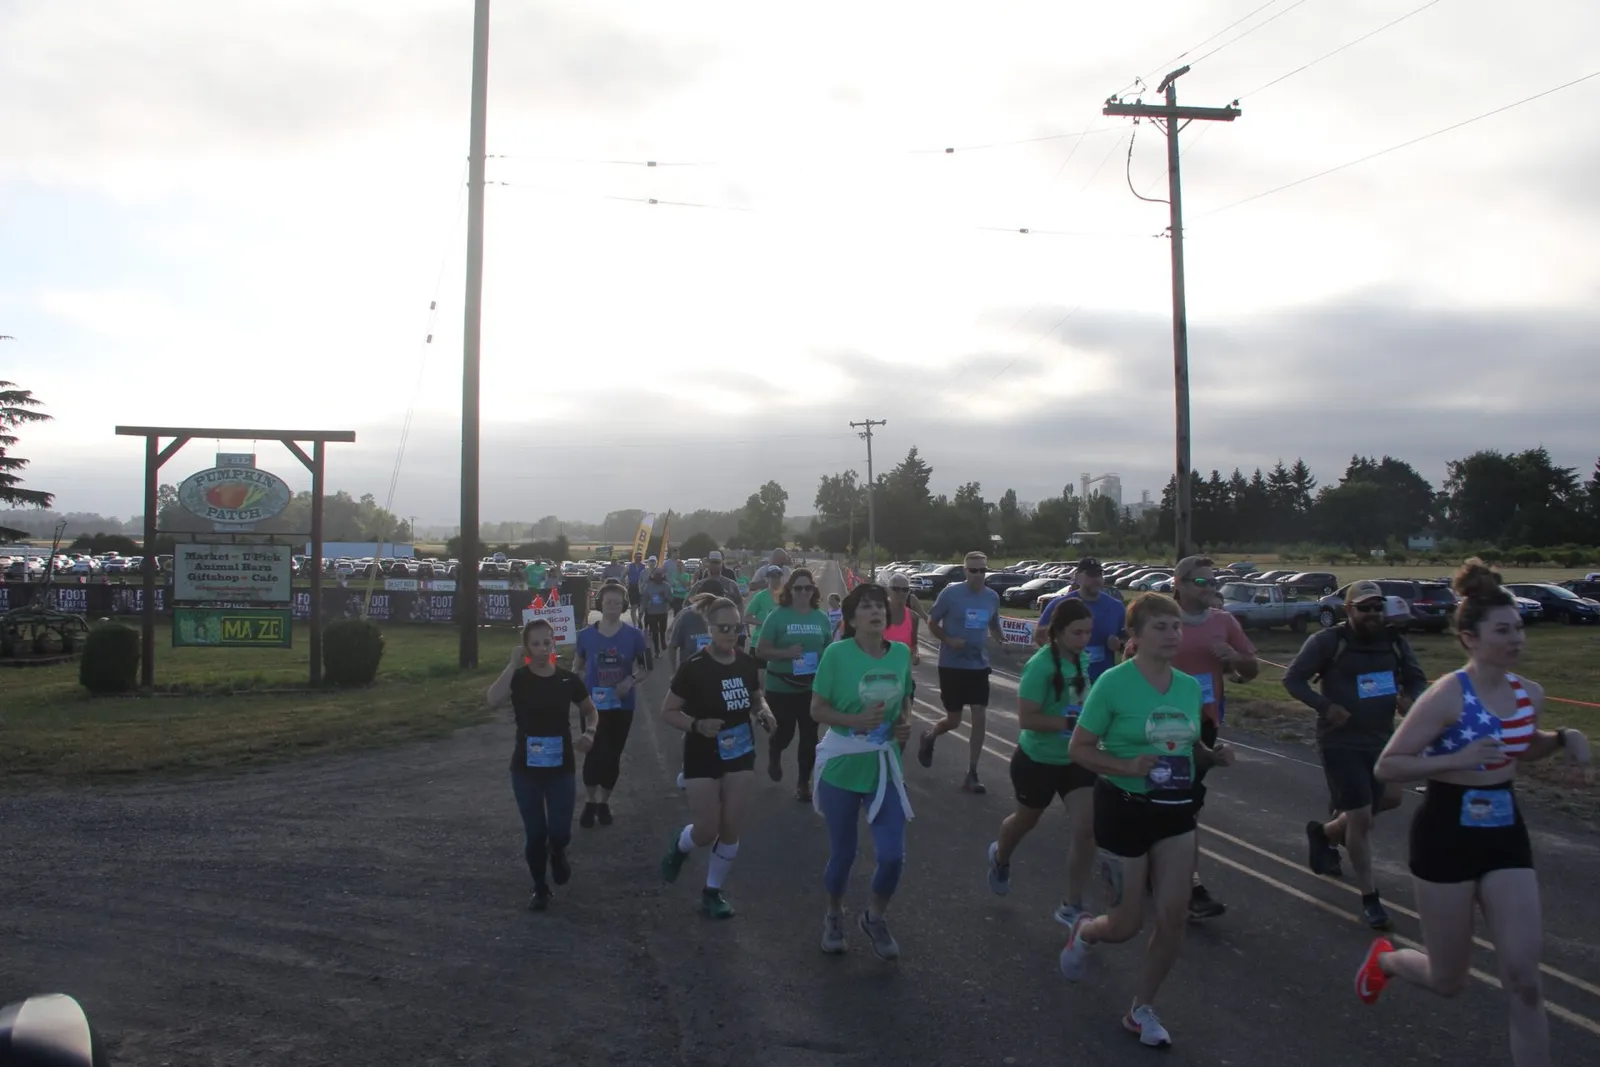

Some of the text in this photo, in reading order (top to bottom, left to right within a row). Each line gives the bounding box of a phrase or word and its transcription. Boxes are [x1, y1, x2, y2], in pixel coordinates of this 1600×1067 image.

[194, 470, 276, 488] PUMPKIN
[206, 507, 261, 520] PATCH
[184, 552, 229, 560] Market
[194, 563, 272, 572] Animal Barn
[187, 573, 279, 583] Giftshop Cafe
[60, 589, 87, 600] FOOT
[489, 594, 510, 607] FOOT
[431, 595, 453, 608] FOOT
[534, 607, 562, 616] Buses
[1003, 620, 1026, 631] EVENT
[721, 677, 744, 690] RUN
[721, 687, 750, 701] WITH
[727, 697, 751, 711] RIVS
